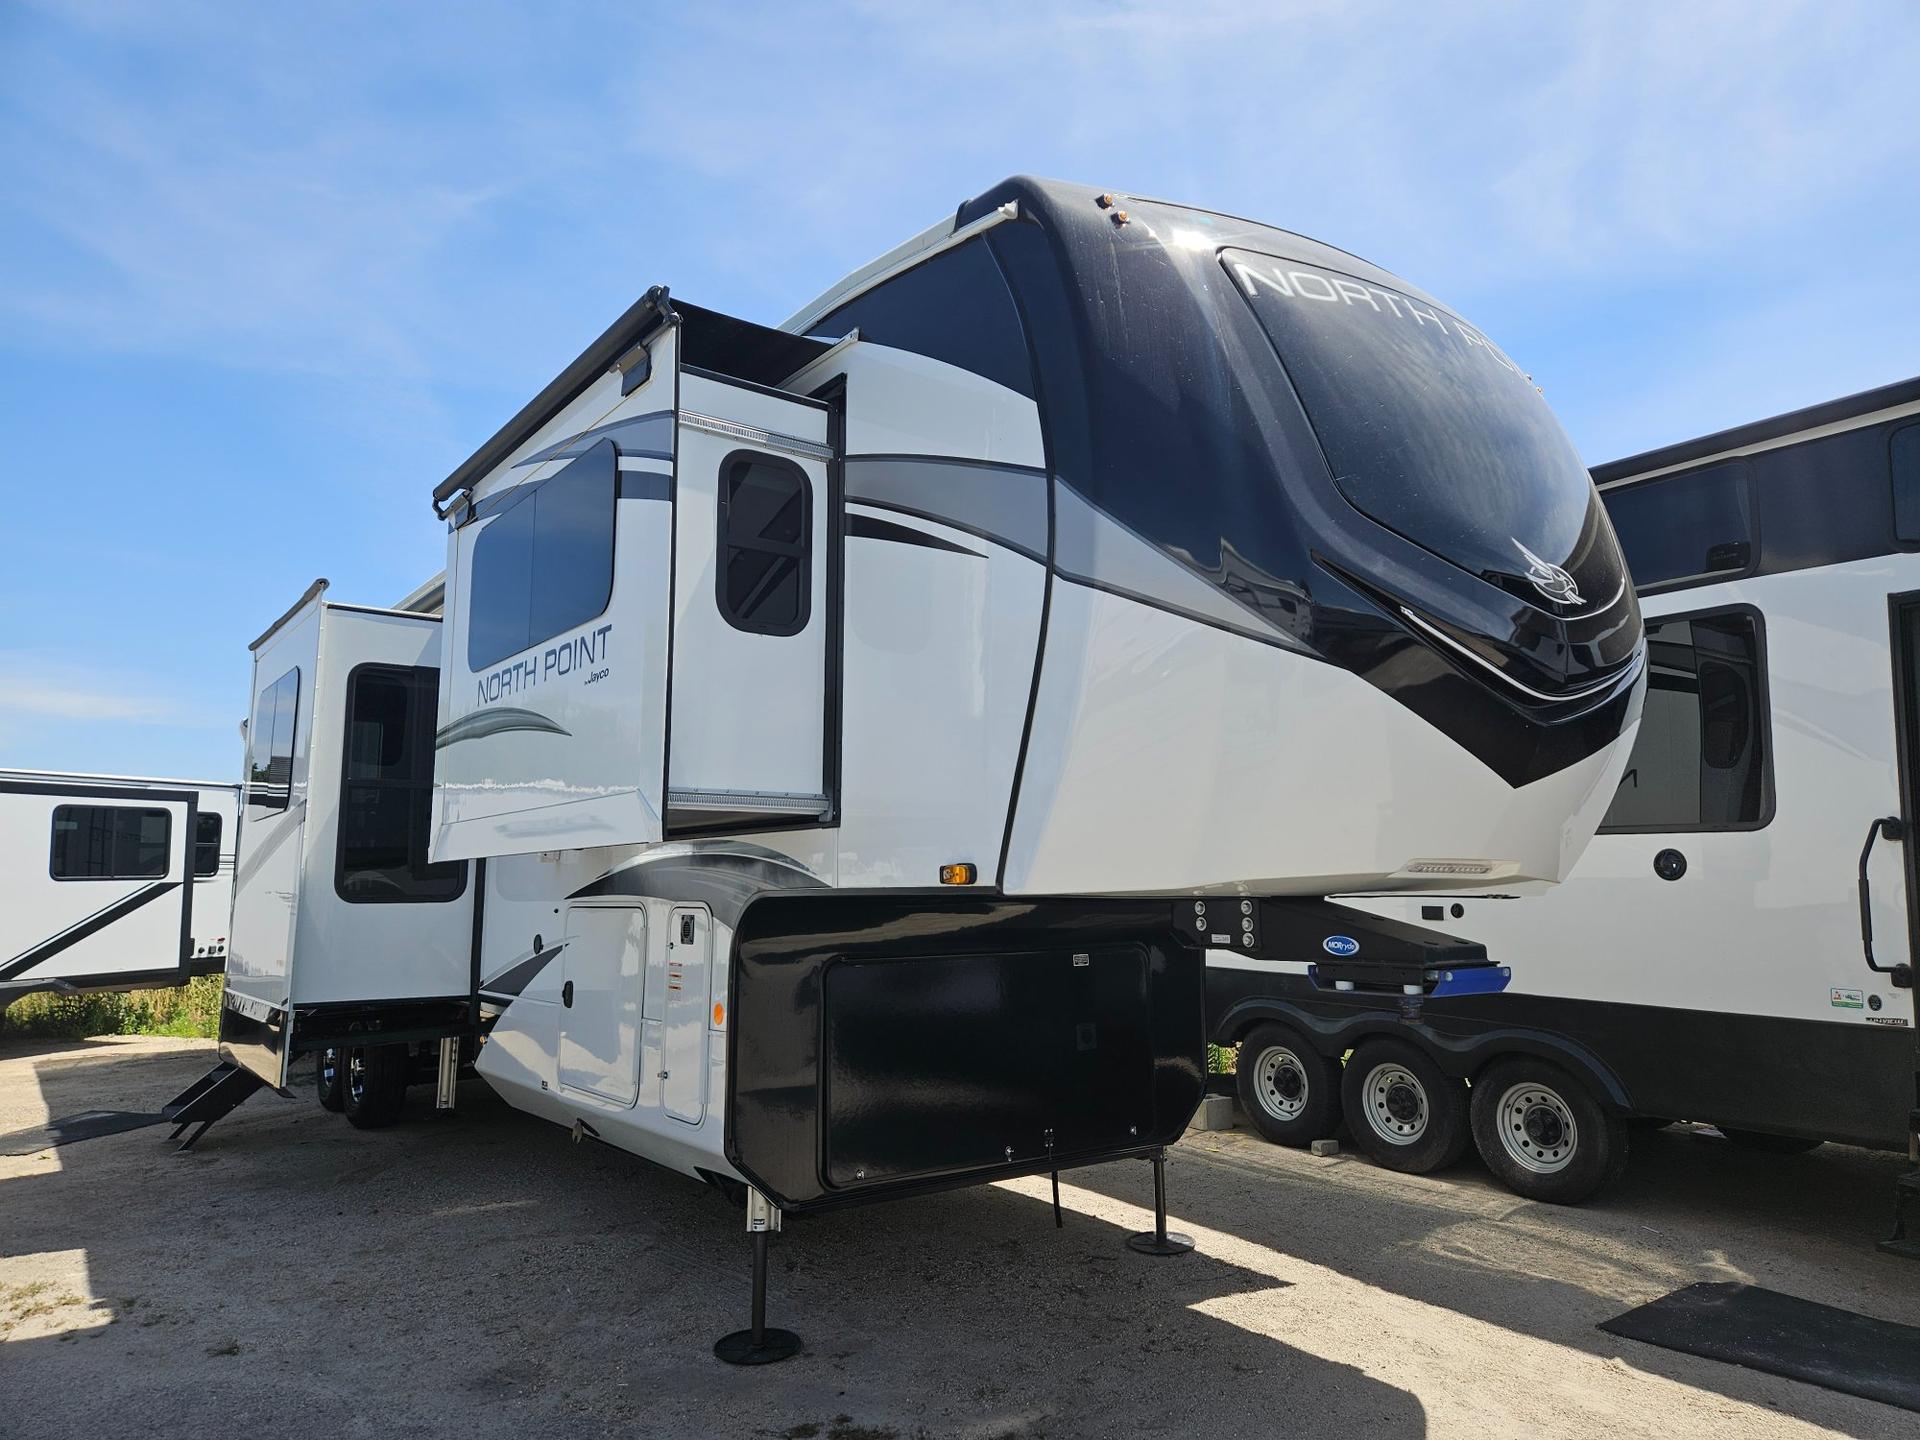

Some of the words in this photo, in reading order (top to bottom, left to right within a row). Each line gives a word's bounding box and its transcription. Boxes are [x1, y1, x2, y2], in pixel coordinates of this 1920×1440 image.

[1233, 263, 1449, 335] NORTH
[477, 656, 537, 707] NORTH
[543, 624, 613, 682] POINT
[588, 667, 610, 684] Jayco
